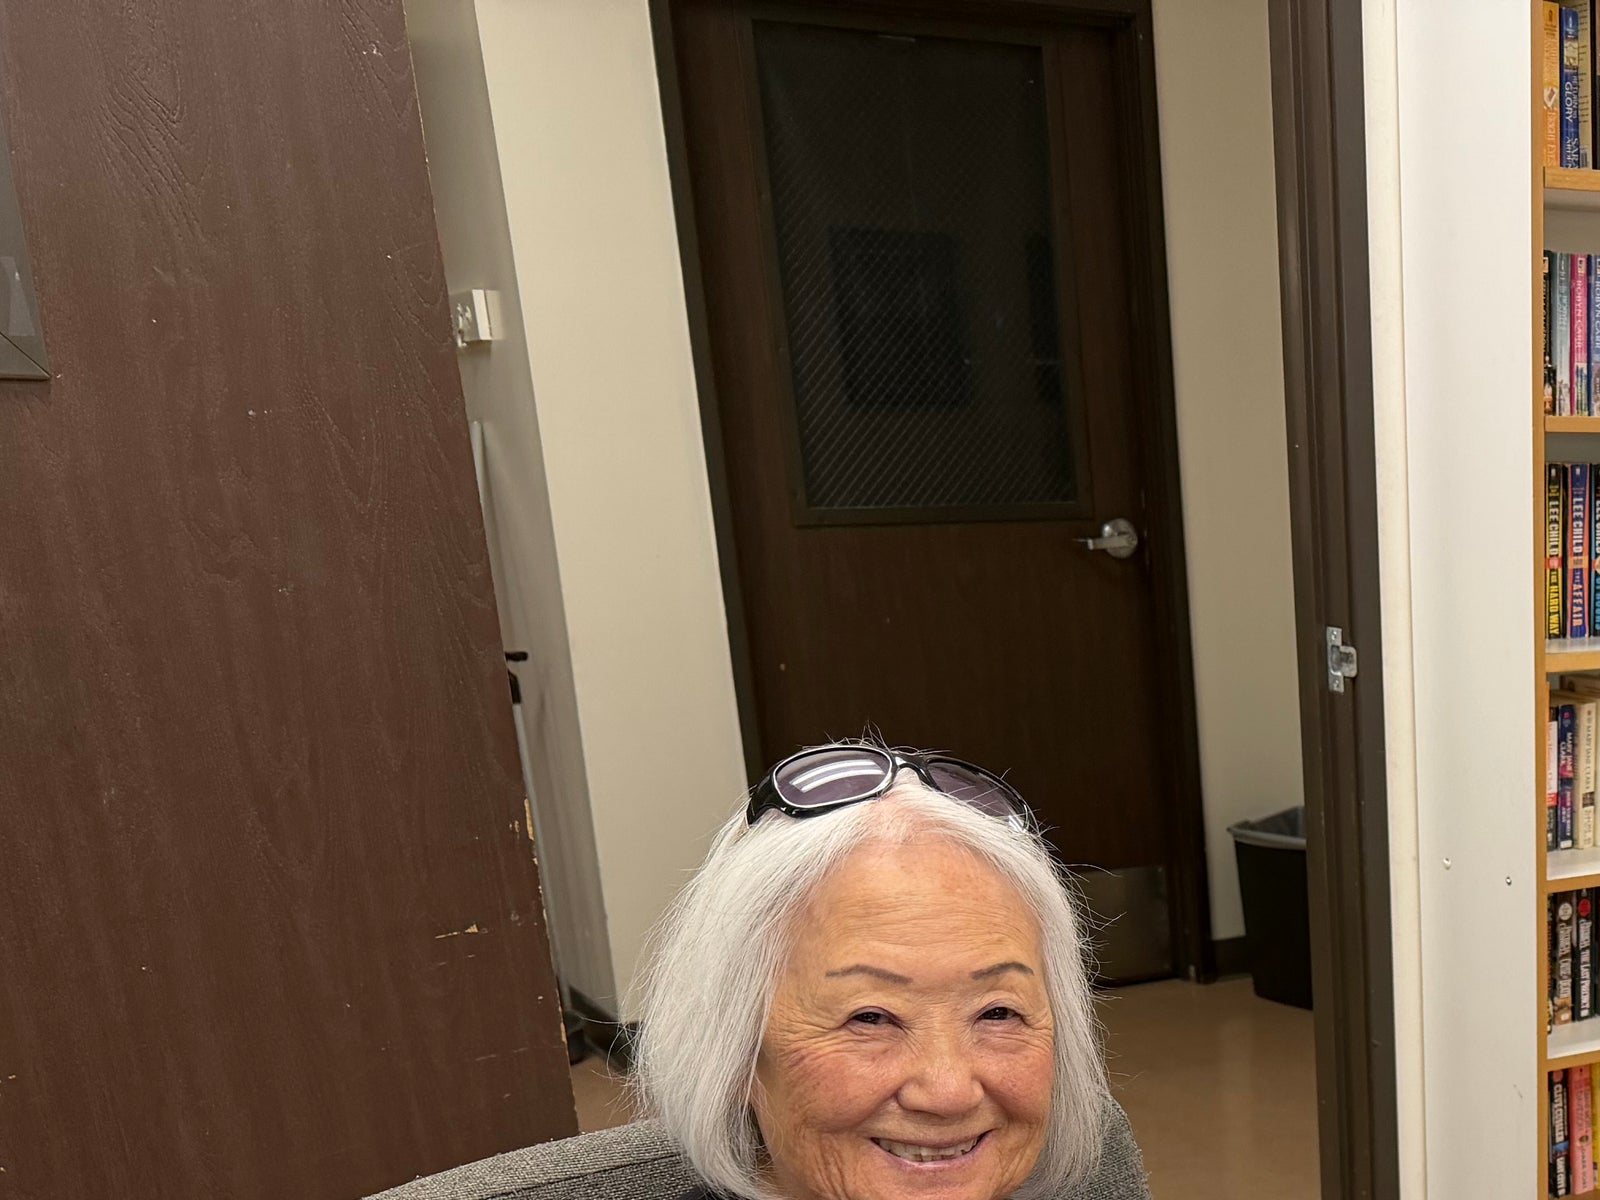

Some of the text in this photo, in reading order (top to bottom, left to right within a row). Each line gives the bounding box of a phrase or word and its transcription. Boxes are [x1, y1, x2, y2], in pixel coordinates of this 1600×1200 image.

[1564, 81, 1573, 122] GLORY
[1549, 501, 1558, 555] LEE CHILD
[1573, 498, 1583, 553] LEE CHILD
[1550, 585, 1559, 610] HARD
[1573, 584, 1583, 626] AFFAIR
[1549, 614, 1559, 635] WAY
